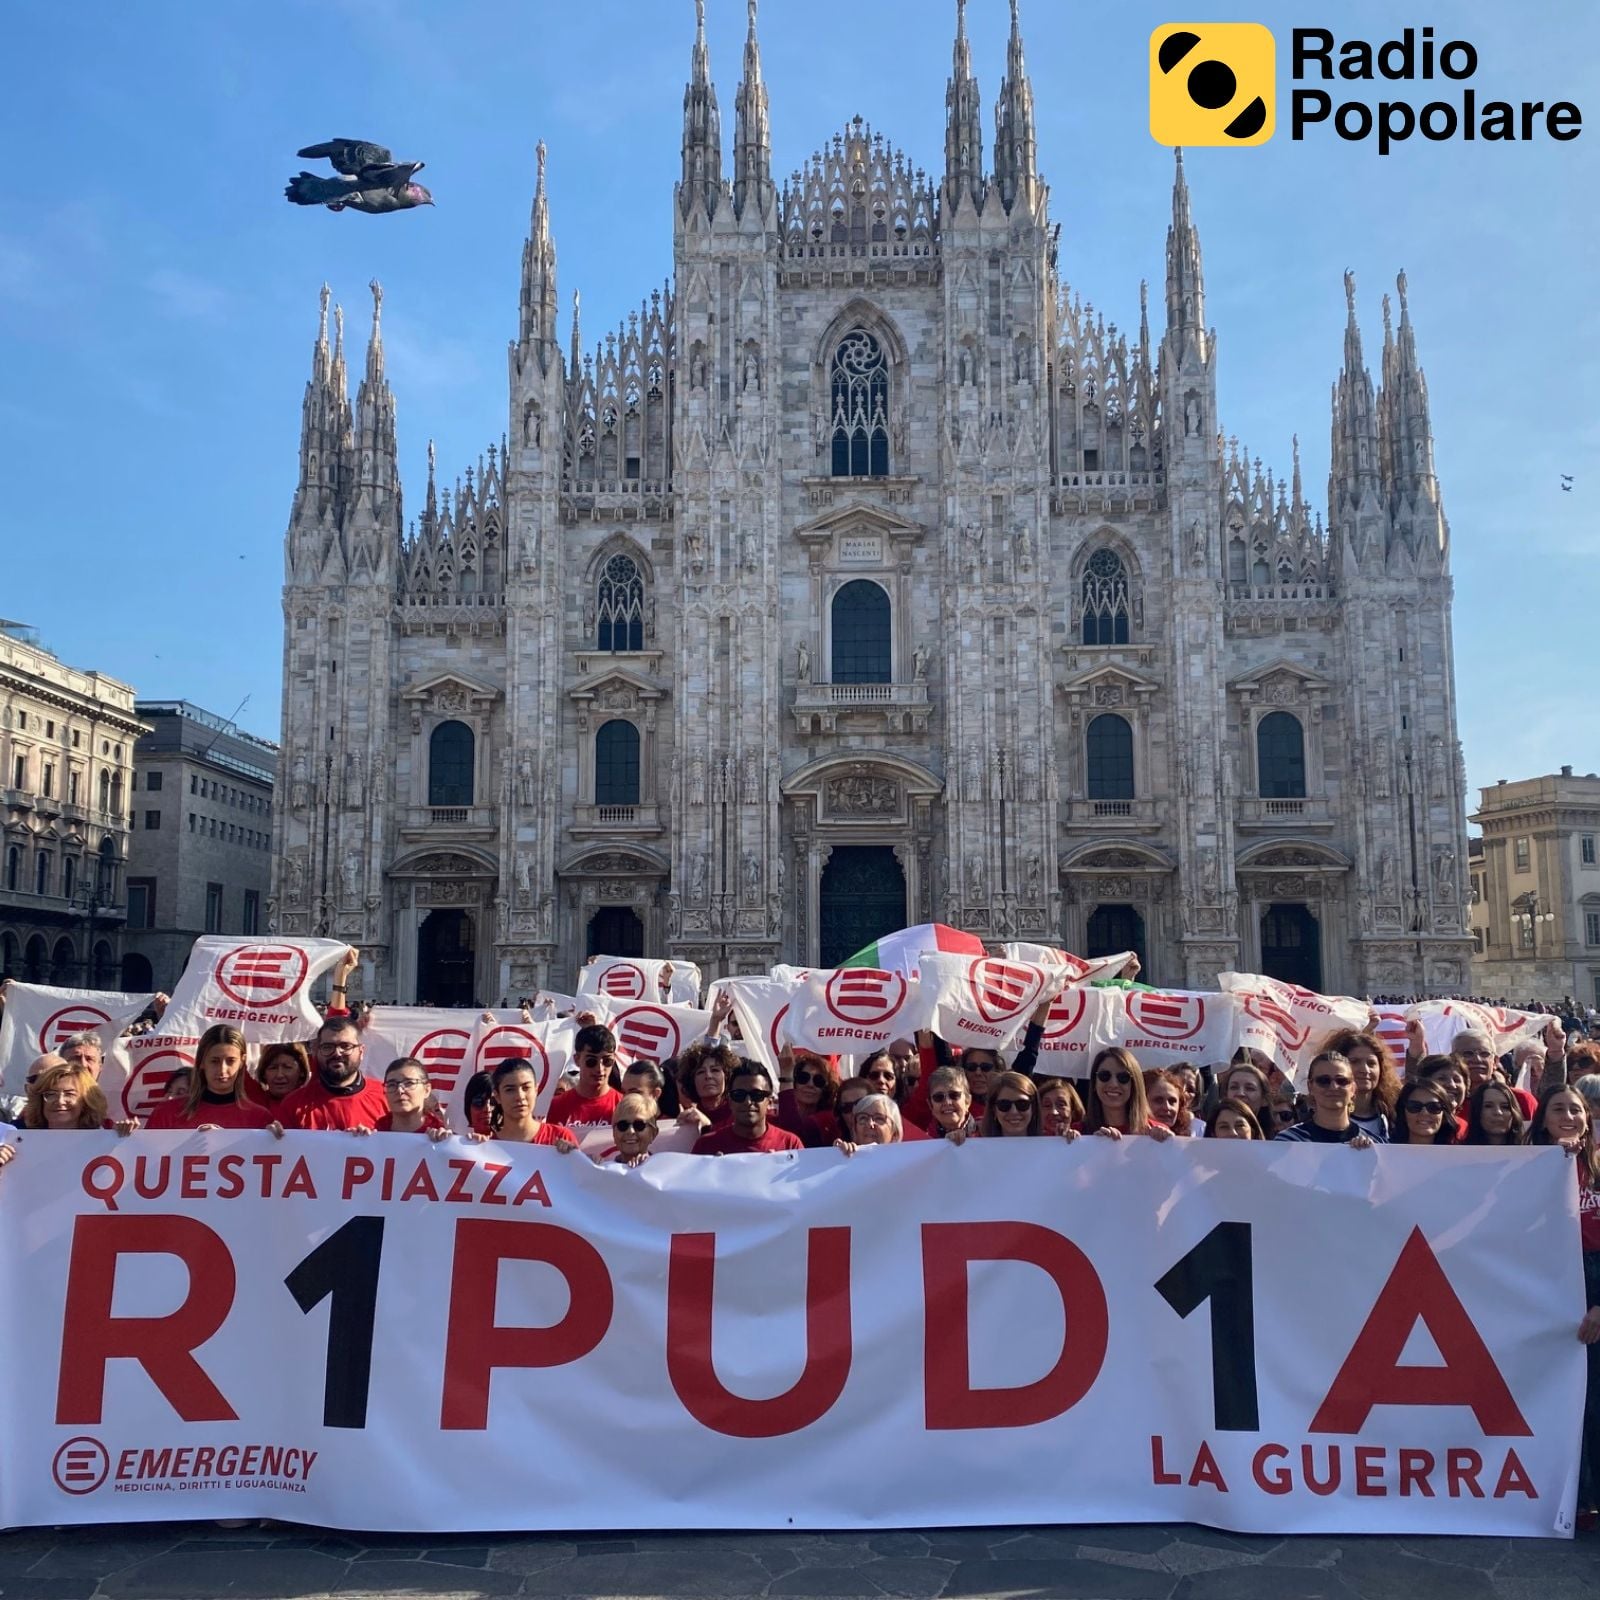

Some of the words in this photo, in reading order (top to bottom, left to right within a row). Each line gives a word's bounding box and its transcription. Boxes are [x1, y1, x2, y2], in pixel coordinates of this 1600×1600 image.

[205, 1007, 299, 1024] EMERGENCY
[1125, 1039, 1206, 1052] EMERGENCY
[81, 1154, 318, 1211] QUESTA
[341, 1156, 553, 1208] PIAZZA
[115, 1445, 318, 1480] EMERGENCY
[1151, 1435, 1229, 1493] LA
[1252, 1443, 1539, 1499] GUERRA
[114, 1482, 175, 1493] MEDICINA,
[179, 1480, 220, 1490] DIRITTI
[225, 1480, 231, 1489] E
[235, 1480, 306, 1493] UGUAGLIANZA
